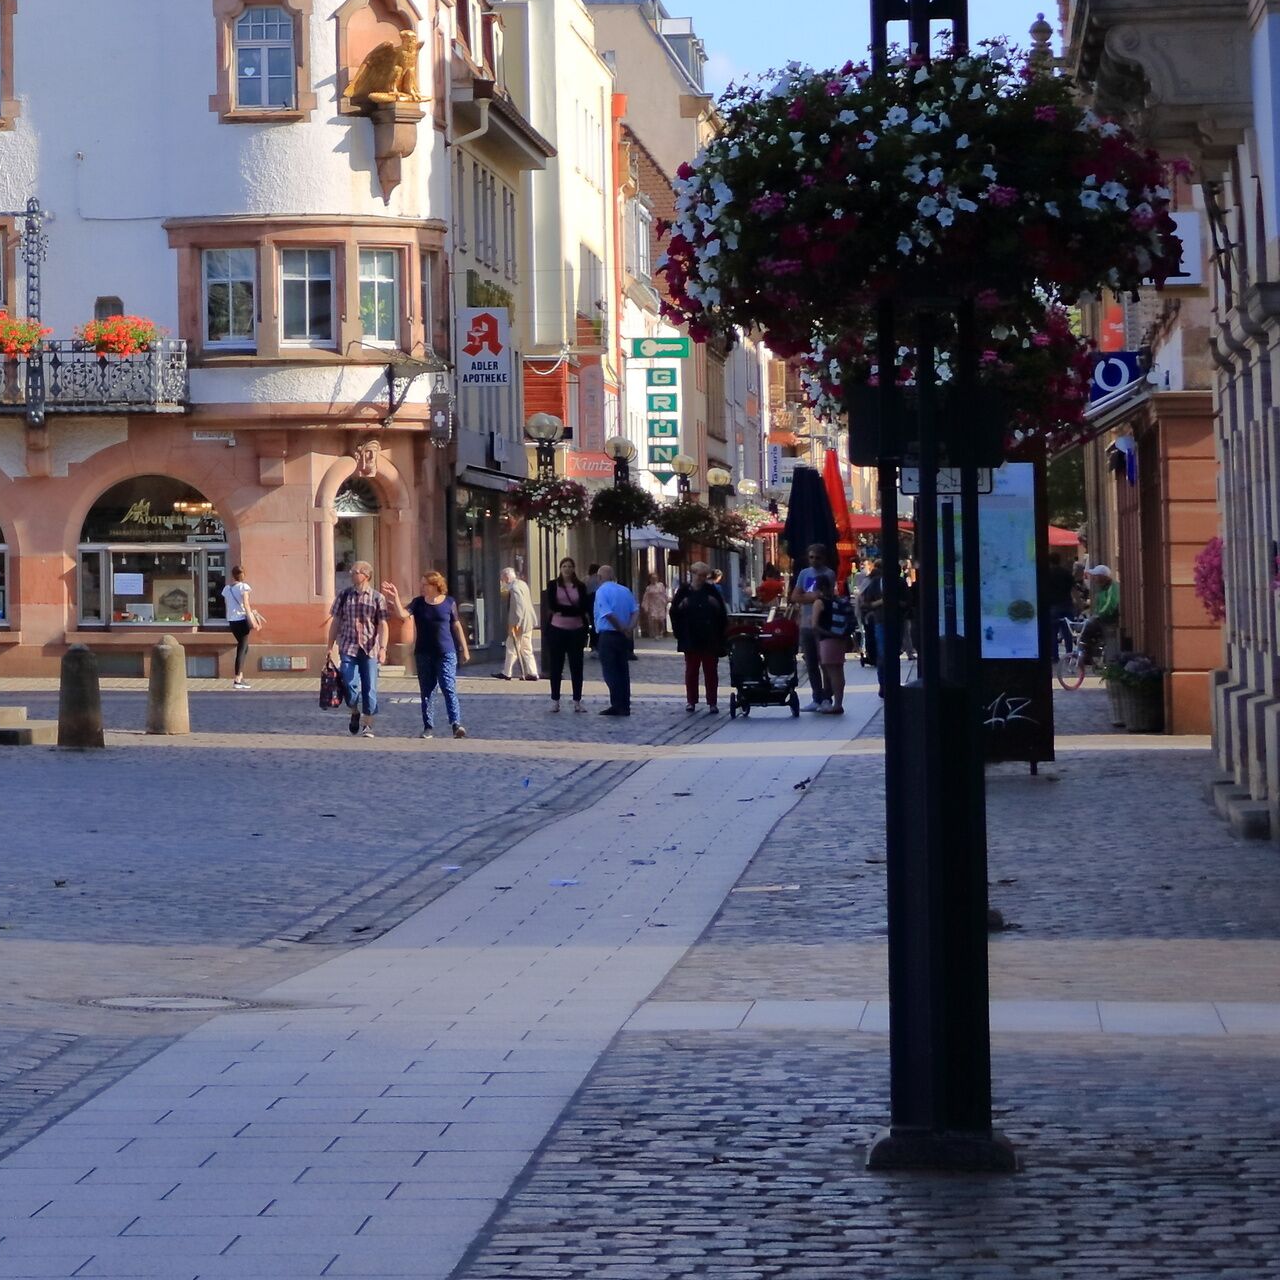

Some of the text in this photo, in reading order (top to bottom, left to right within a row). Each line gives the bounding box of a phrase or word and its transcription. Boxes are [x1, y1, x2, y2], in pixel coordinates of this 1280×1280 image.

[471, 361, 499, 370] ADLER
[462, 373, 508, 383] APOTHEKE
[652, 370, 673, 461] GRÜN
